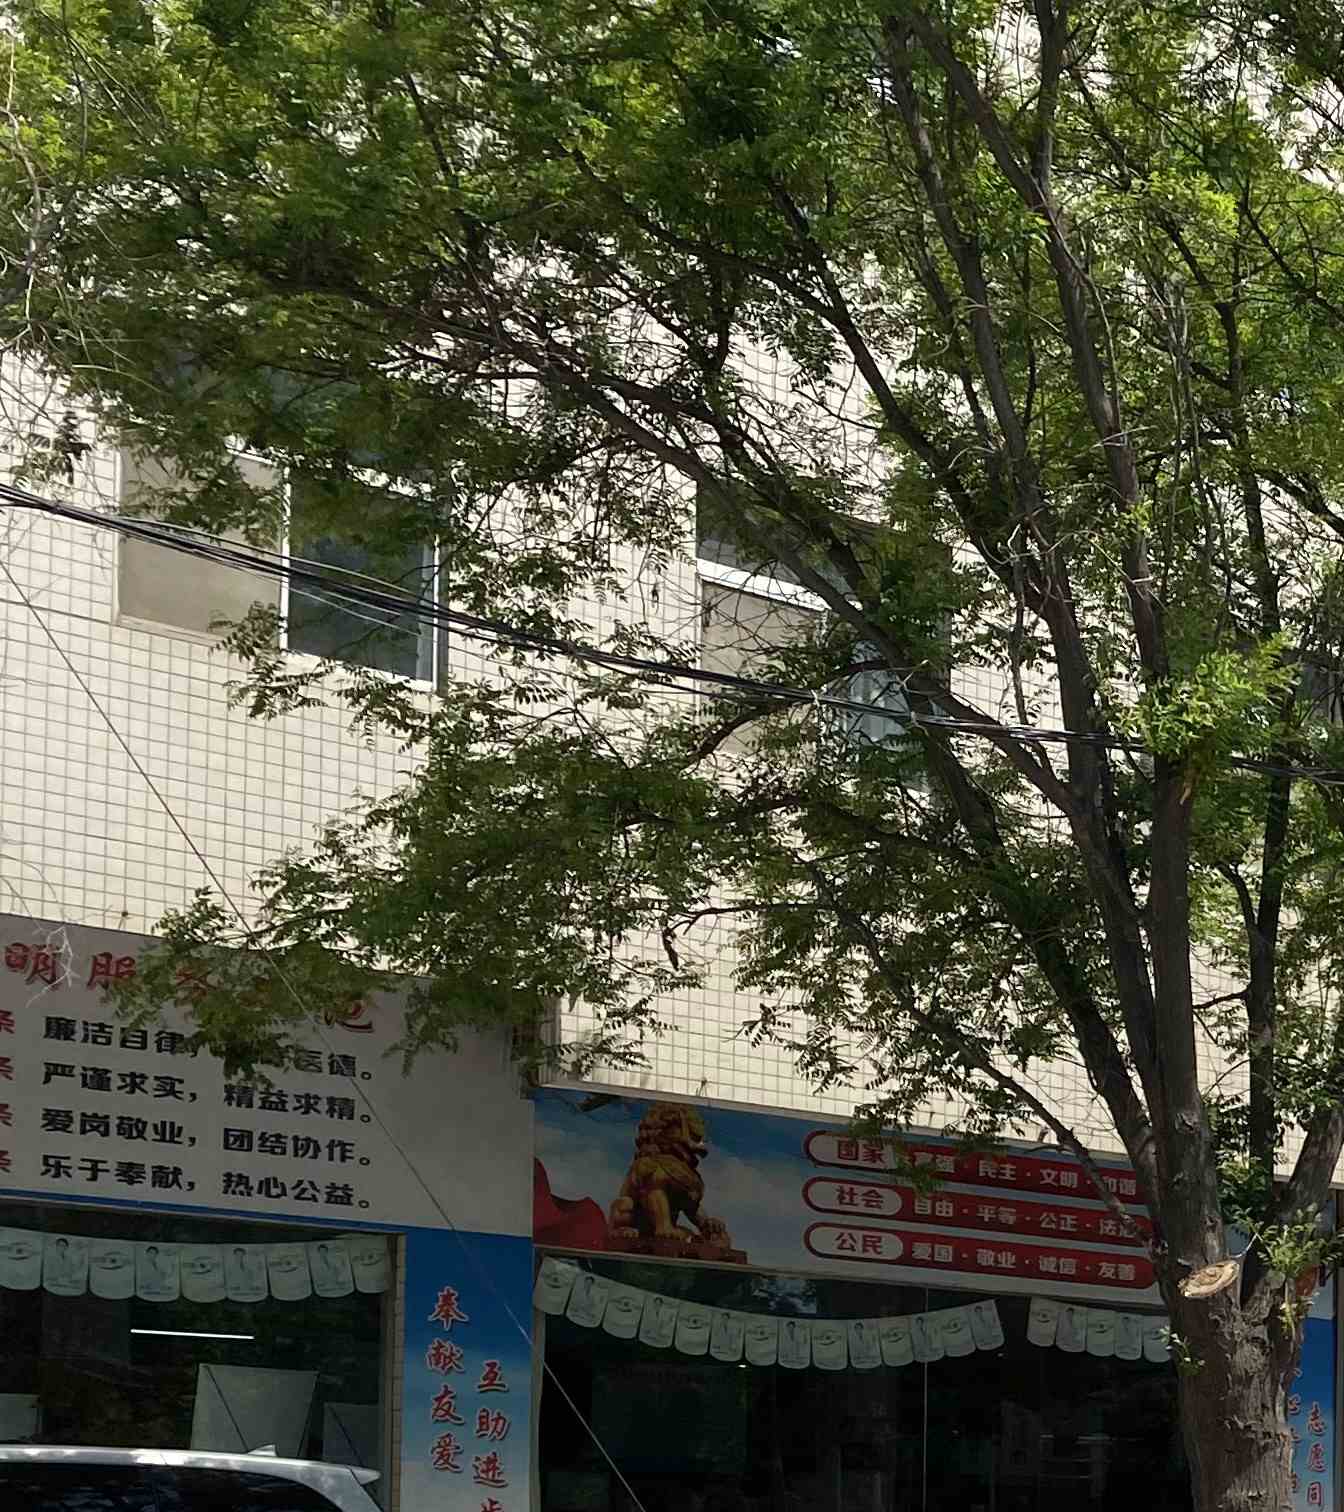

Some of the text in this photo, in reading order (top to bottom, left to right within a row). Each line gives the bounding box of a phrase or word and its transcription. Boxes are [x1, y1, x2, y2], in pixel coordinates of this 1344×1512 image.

[224, 1042, 372, 1081] 医德。
[42, 1062, 198, 1103] 严谨求实，
[223, 1084, 372, 1124] 精益求精。
[40, 1108, 197, 1148] 爱岗敬业，
[223, 1127, 371, 1167] 团结协作。
[837, 1140, 885, 1166] 国家
[40, 1154, 196, 1192] 乐于奉献，
[222, 1171, 371, 1210] 热心公益。
[836, 1186, 884, 1208] 社会
[836, 1231, 883, 1256] 公民
[425, 1286, 469, 1474] 奉献友爱
